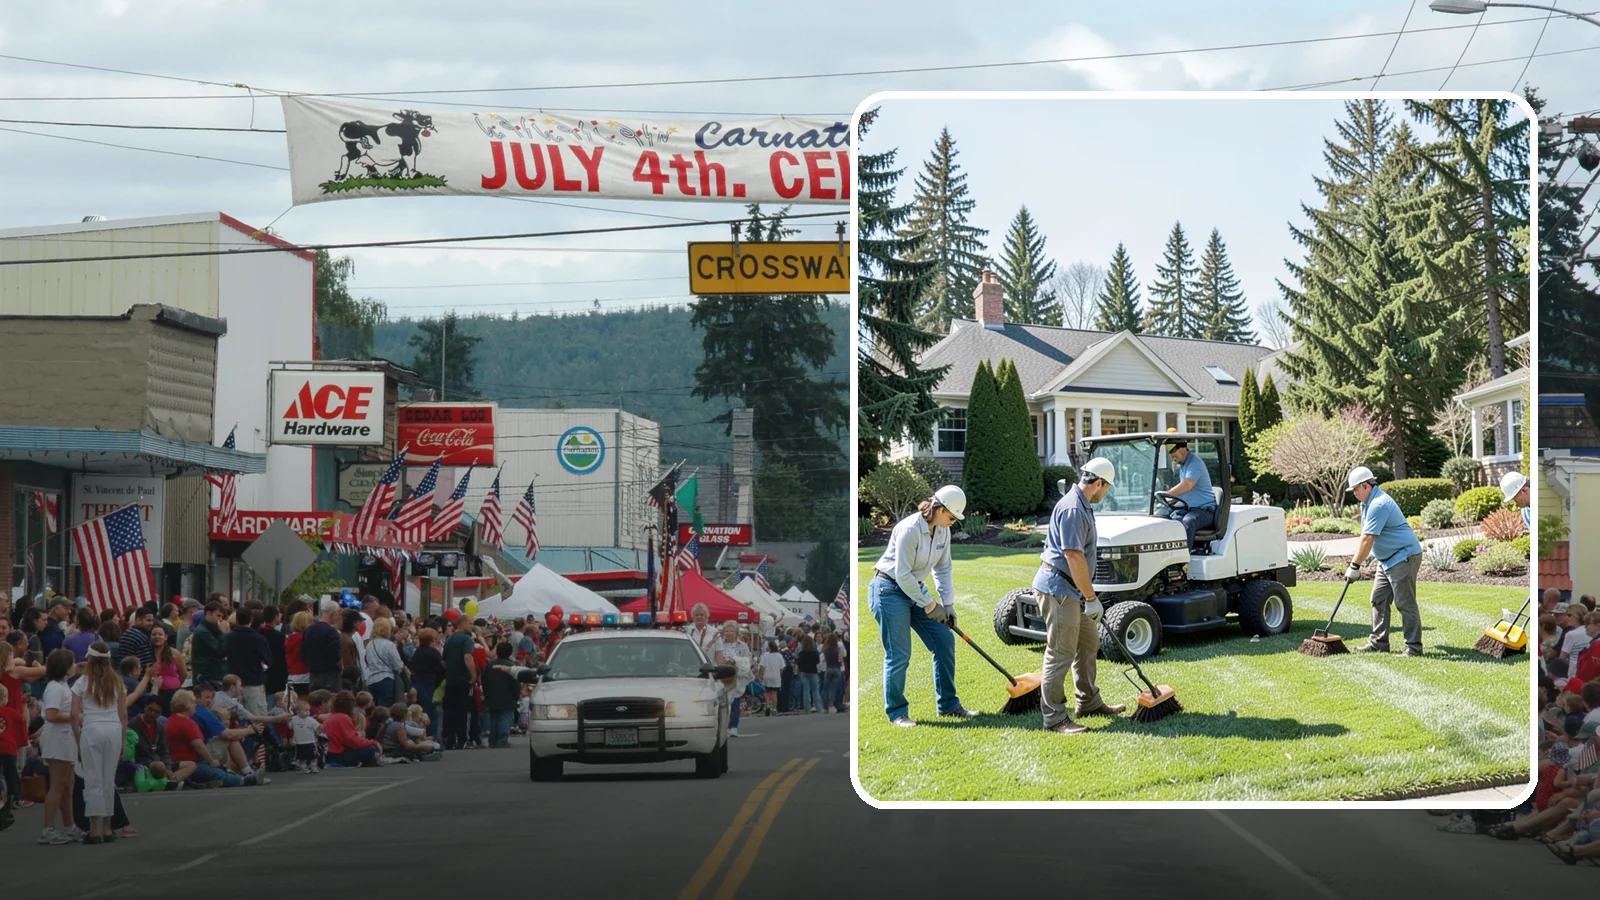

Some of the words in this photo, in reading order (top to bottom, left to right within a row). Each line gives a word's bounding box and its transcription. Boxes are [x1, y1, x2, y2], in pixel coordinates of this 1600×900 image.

[481, 141, 604, 193] JULY
[632, 150, 747, 198] 4th.
[697, 254, 850, 280] CROSSWA
[282, 380, 373, 420] ACE
[283, 421, 371, 436] Hardware
[416, 428, 477, 447] Coca-Cola
[353, 467, 385, 480] Simpl
[83, 484, 93, 494] St.
[96, 485, 124, 495] Vincent
[126, 485, 135, 495] de
[138, 486, 155, 495] Paul
[688, 526, 741, 535] CRNATION
[699, 535, 730, 543] GLASS
